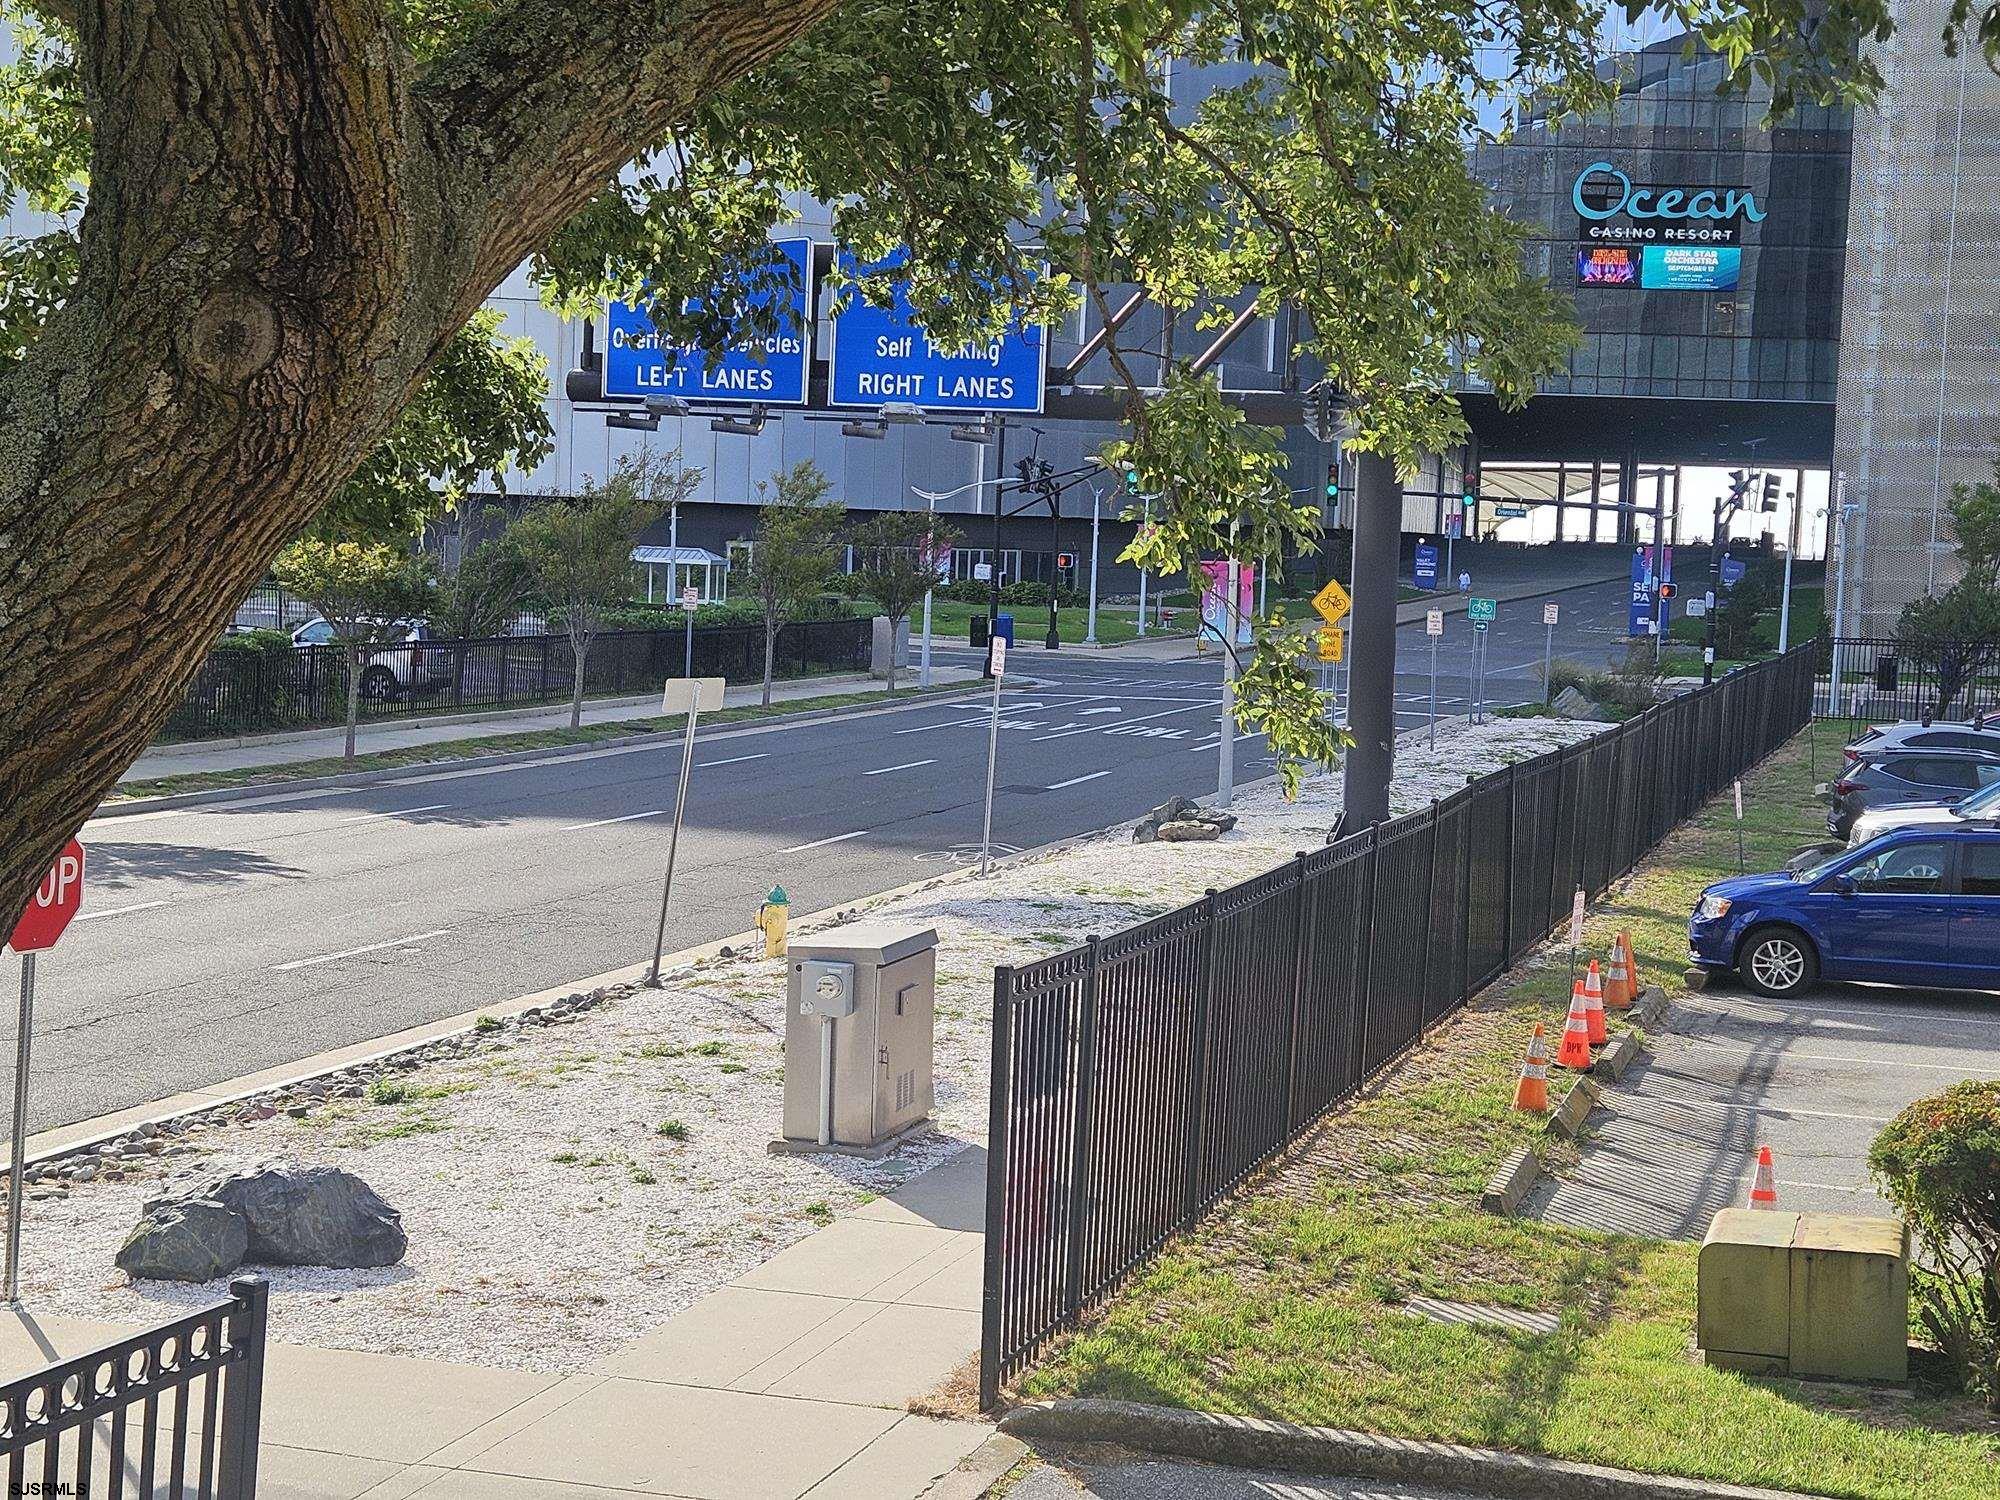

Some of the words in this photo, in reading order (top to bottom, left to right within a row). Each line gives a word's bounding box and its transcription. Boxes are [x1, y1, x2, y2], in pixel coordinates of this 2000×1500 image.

[1572, 161, 1768, 223] Ocean
[1589, 226, 1657, 239] CASINO
[1664, 228, 1734, 241] RESORT
[1663, 256, 1719, 265] ORCHESTRA
[1665, 249, 1691, 257] DARK
[1693, 250, 1718, 258] STAR
[875, 335, 912, 358] Self
[636, 365, 688, 388] LEFT
[702, 368, 774, 391] LANES
[858, 373, 925, 397] RIGHT
[937, 375, 1014, 399] LANES
[36, 856, 79, 908] OP
